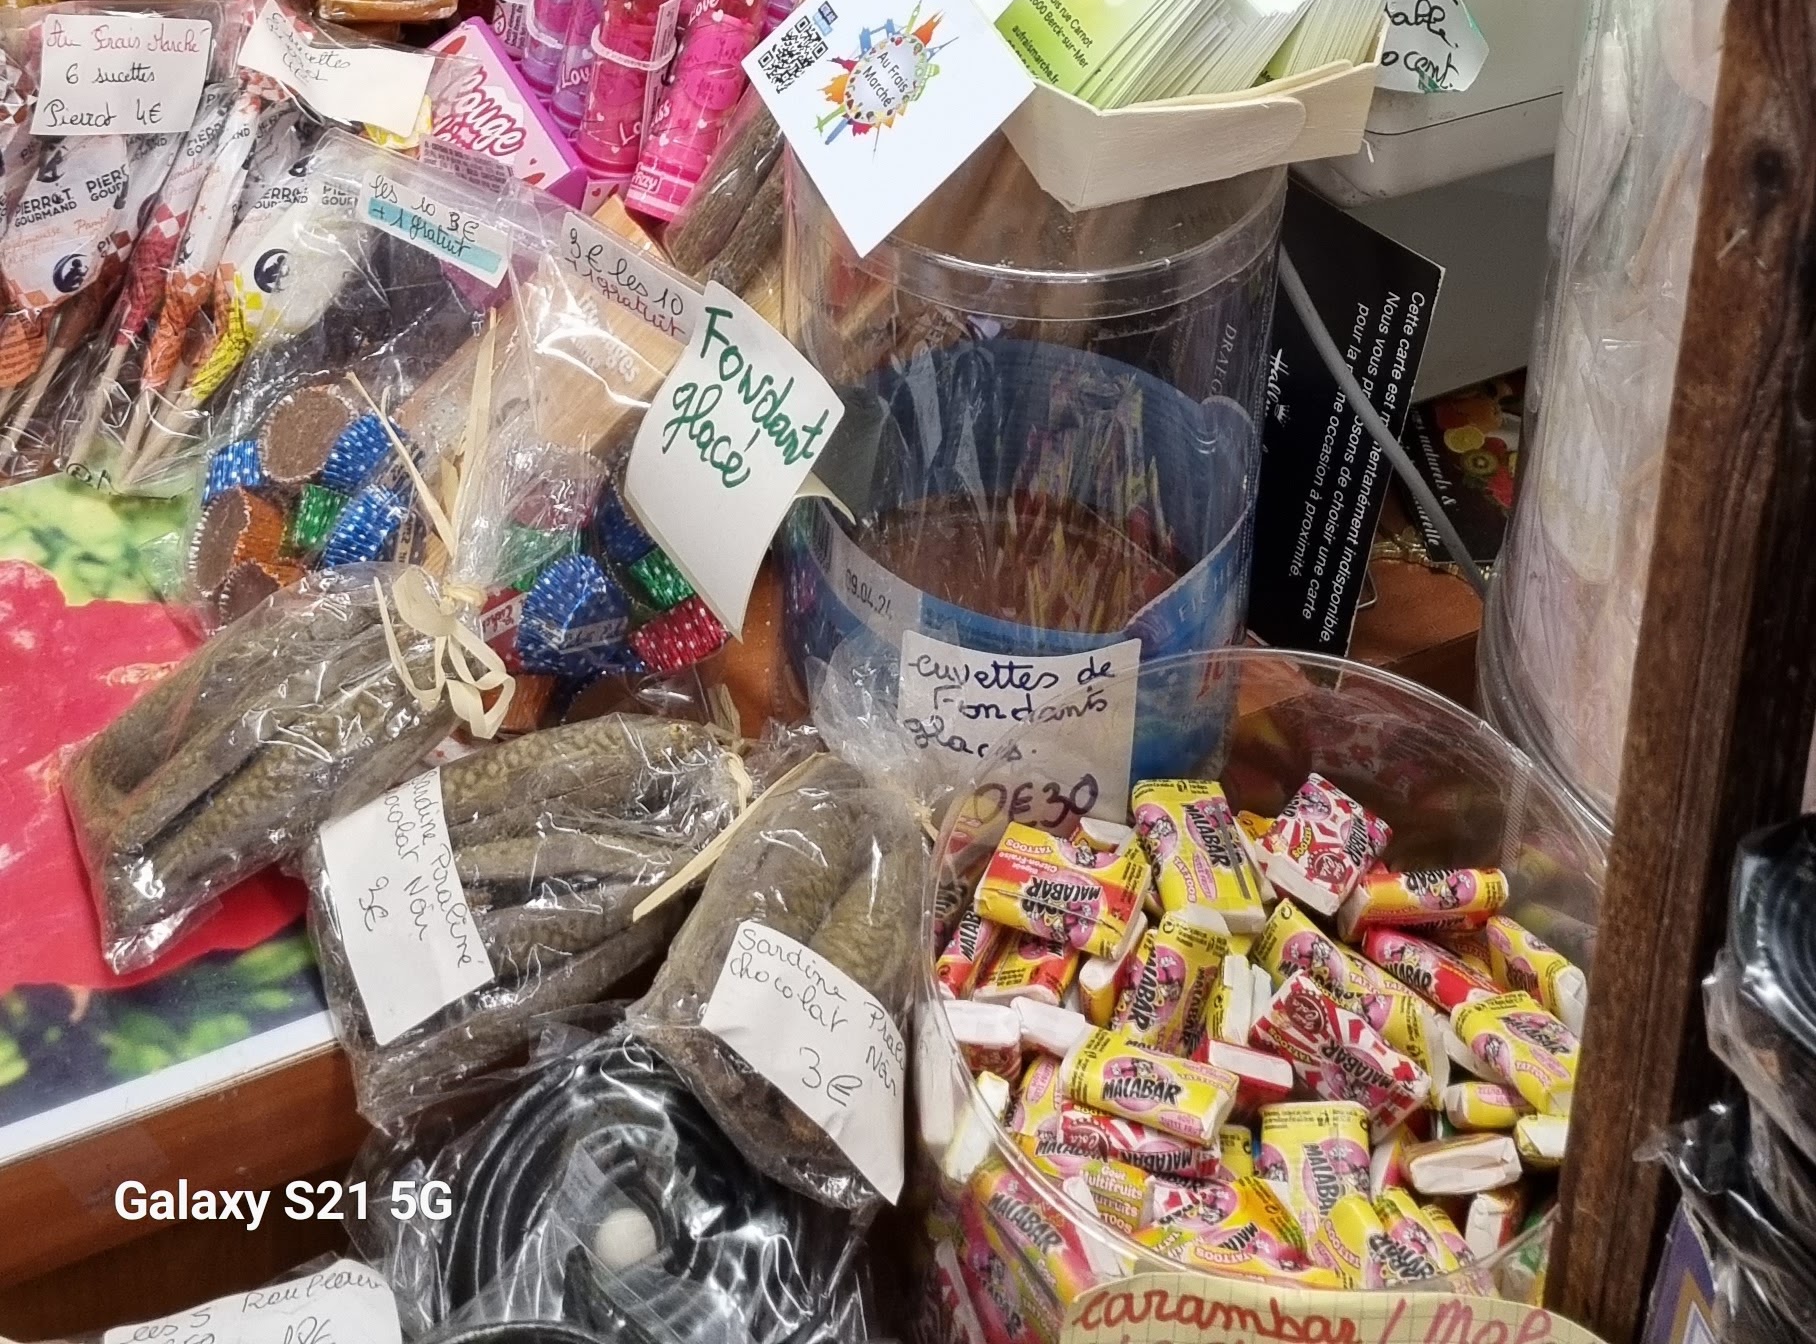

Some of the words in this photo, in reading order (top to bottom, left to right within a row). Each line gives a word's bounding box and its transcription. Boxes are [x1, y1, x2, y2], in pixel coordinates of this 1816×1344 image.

[46, 20, 81, 50] Au
[92, 23, 142, 53] Frais
[147, 20, 210, 55] Marché
[1042, 9, 1089, 69] Berck-sur-Mer
[1059, 5, 1073, 23] rue
[1069, 15, 1094, 49] Carnot
[65, 63, 79, 86] 6
[92, 61, 156, 86] sucettes
[876, 51, 891, 68] Au
[887, 65, 909, 94] Frais
[1011, 24, 1060, 86] aufraismarche.fr
[861, 65, 896, 109] Marché
[43, 98, 118, 128] Pierrot
[135, 97, 163, 125] 4€
[370, 173, 398, 204] les
[14, 199, 78, 228] GOURMAND
[611, 258, 651, 302] les
[653, 283, 685, 316] 10
[1352, 301, 1371, 344] pour
[1377, 290, 1401, 335] Nous
[1402, 290, 1426, 337] Cette
[1366, 338, 1386, 377] vous
[1391, 337, 1411, 381] carte
[700, 305, 830, 466] Fondant
[1383, 382, 1399, 411] est
[661, 381, 762, 490] glacé
[1312, 414, 1341, 488] occasion
[1288, 499, 1318, 578] proximité.
[1326, 490, 1346, 546] choisir
[1313, 546, 1331, 577] une
[1301, 578, 1321, 621] carte
[1318, 546, 1355, 644] indisponible.
[1075, 654, 1118, 685] de
[1004, 837, 1053, 856] TATTOOS
[1181, 801, 1232, 868] MALABAR
[1173, 855, 1198, 904] TATTOOS
[736, 926, 849, 1003] Sardine
[1132, 939, 1158, 1032] MALABAR
[798, 1045, 864, 1109] 3€
[1101, 1076, 1182, 1106] MALABAR
[1078, 1167, 1144, 1201] Multifruits
[986, 1191, 1062, 1254] MALABAR
